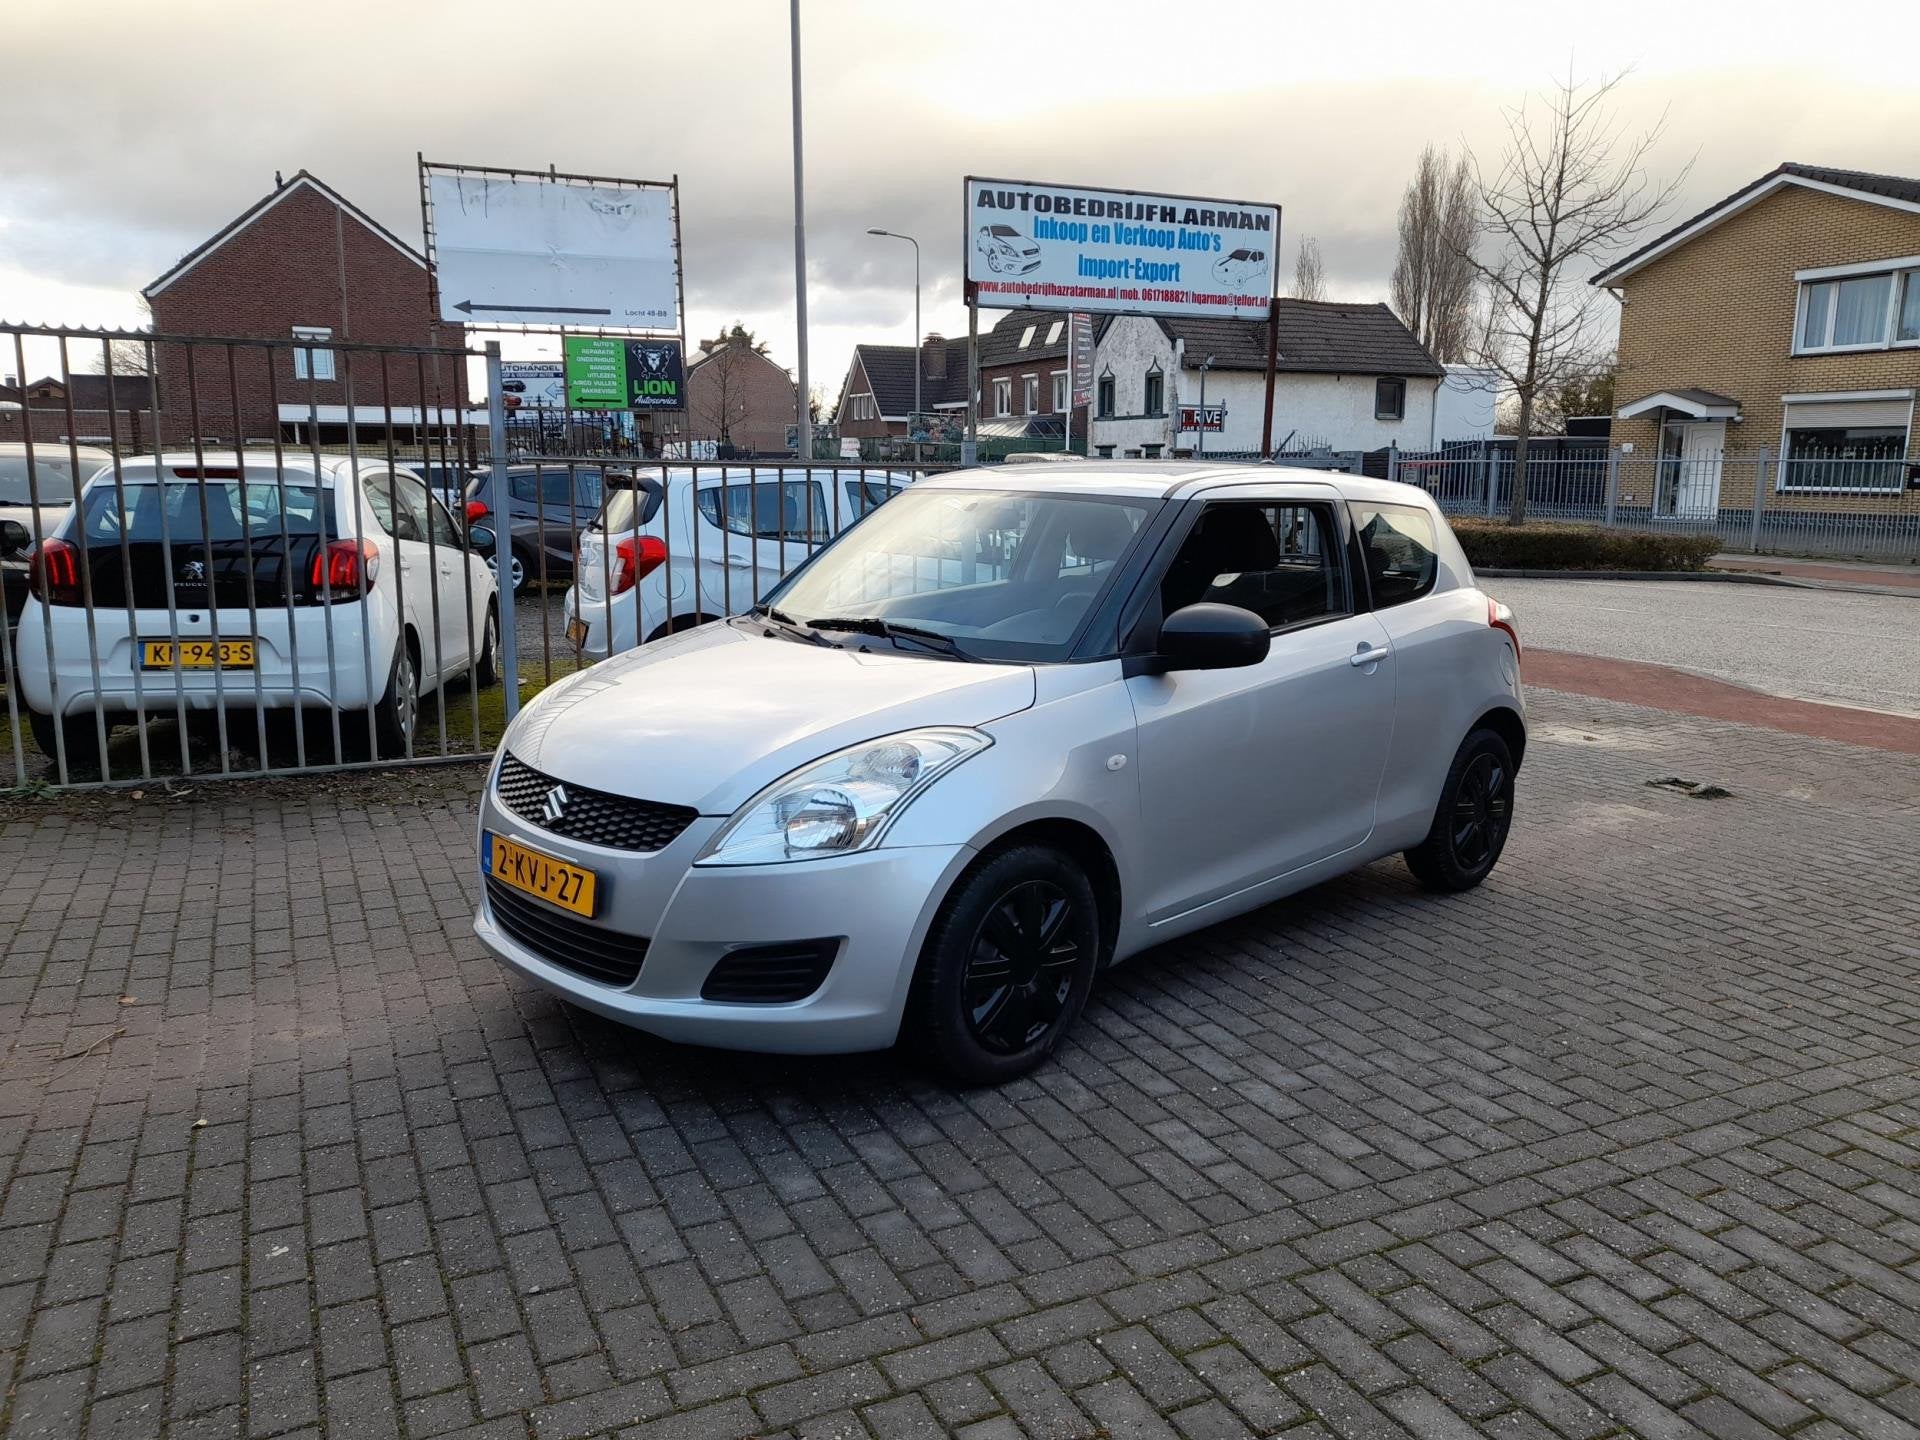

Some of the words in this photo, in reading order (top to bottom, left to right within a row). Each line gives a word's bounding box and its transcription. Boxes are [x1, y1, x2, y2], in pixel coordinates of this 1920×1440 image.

[1034, 215, 1088, 244] Inkoop
[1091, 222, 1110, 243] en
[1114, 222, 1175, 251] Verkoop
[1178, 227, 1221, 252] Auto's
[1078, 254, 1180, 283] Import-Export
[1120, 288, 1140, 300] mob.
[633, 379, 676, 395] LION
[634, 394, 678, 405] Autoservice
[498, 844, 585, 905] 2-KVJ-27
